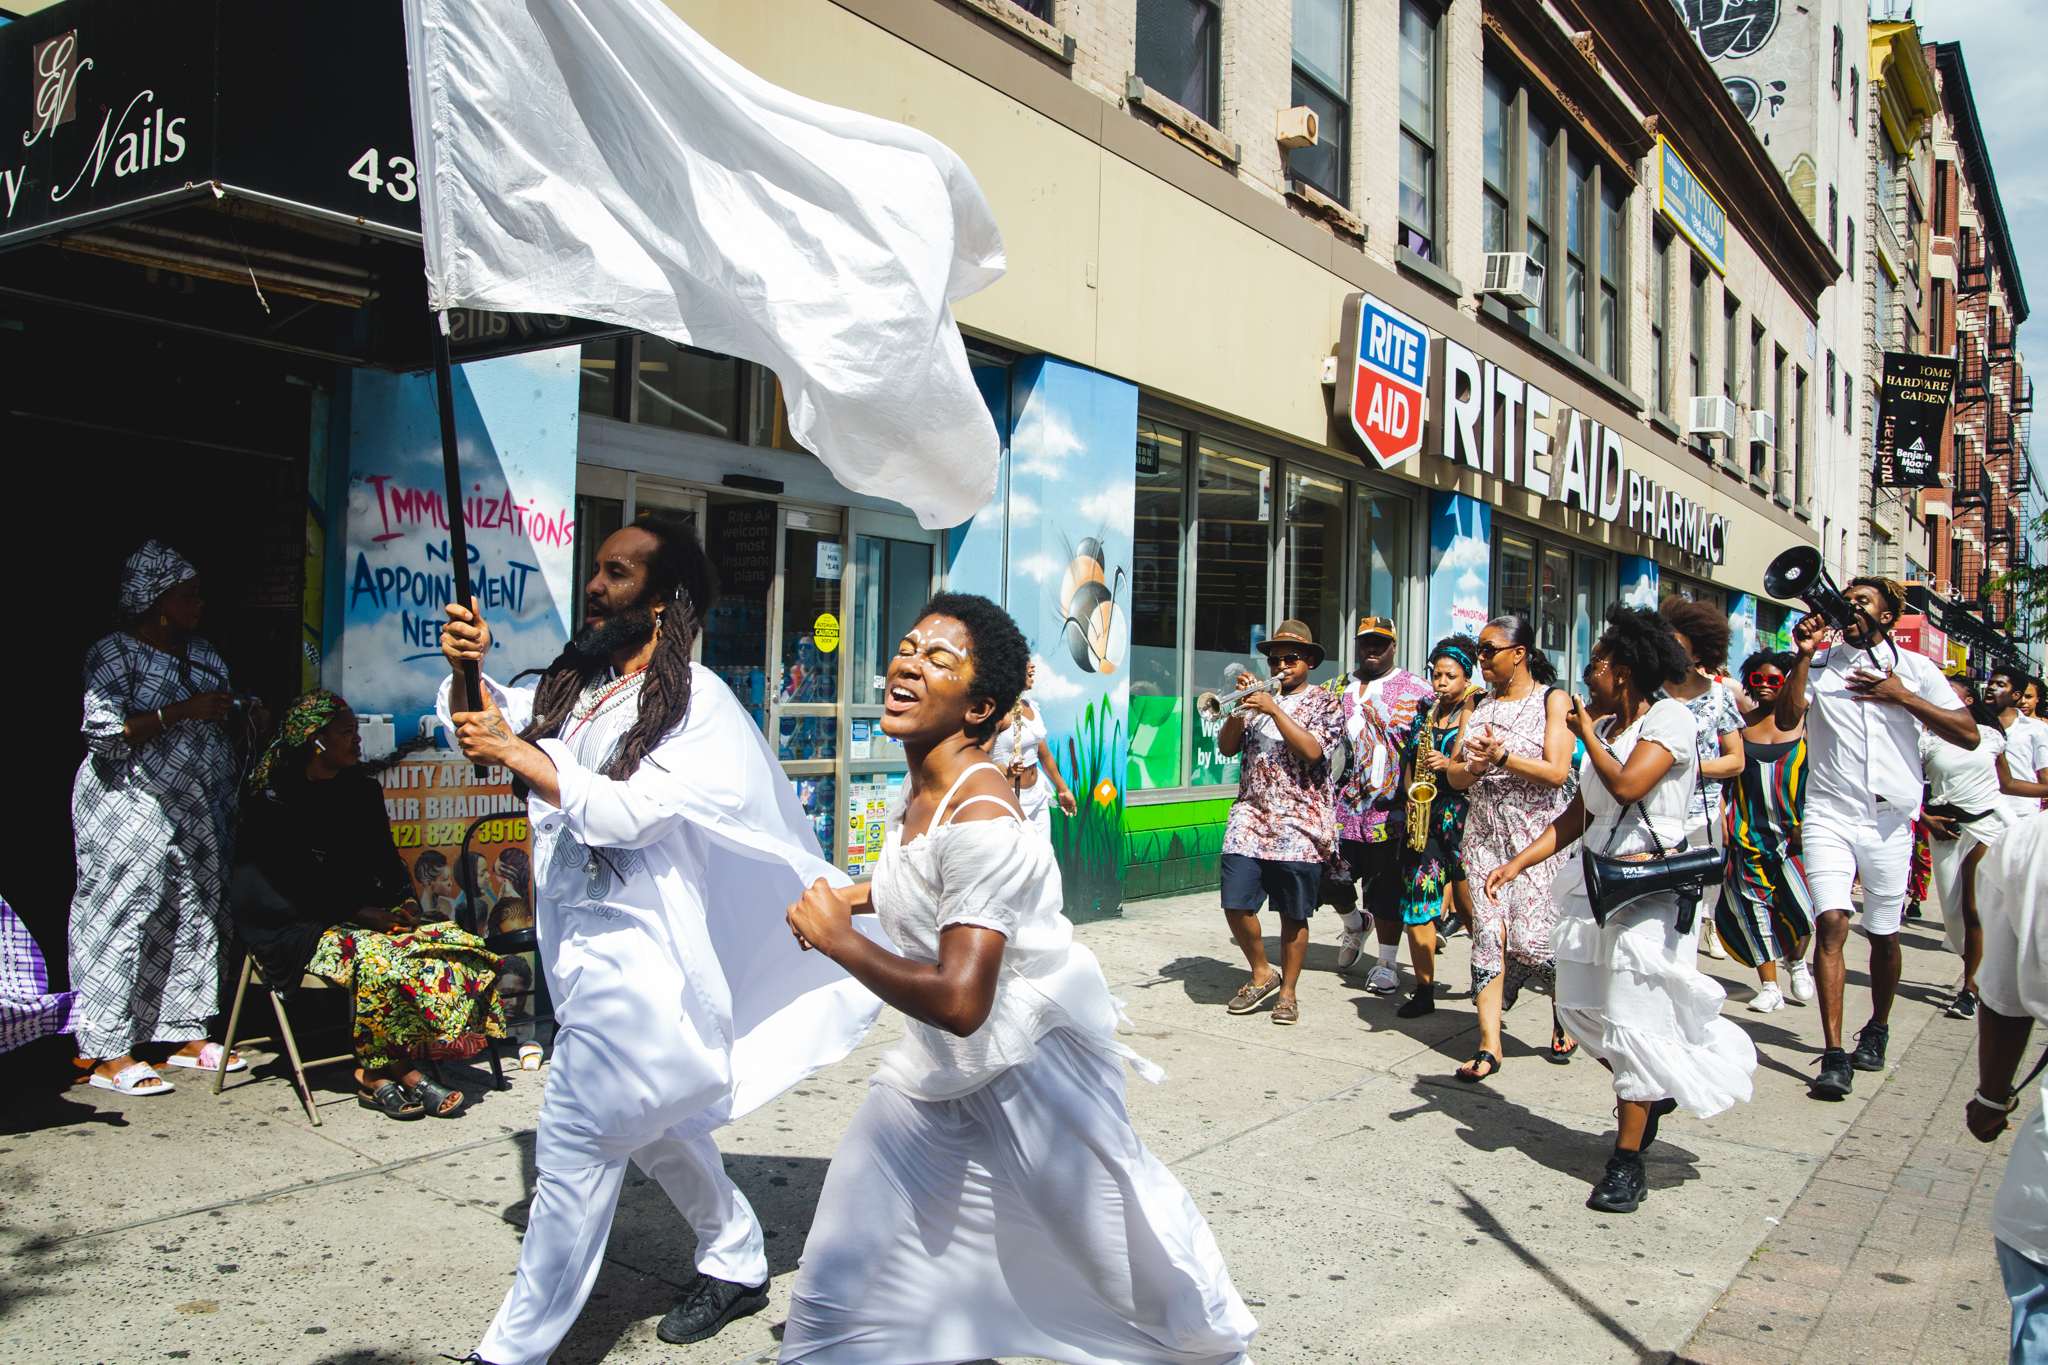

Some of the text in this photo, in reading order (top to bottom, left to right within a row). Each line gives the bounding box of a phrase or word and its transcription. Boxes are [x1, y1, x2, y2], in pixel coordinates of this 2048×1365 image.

[51, 89, 186, 202] Nails
[1666, 152, 1682, 178] STUDIO
[1683, 168, 1724, 240] TATTOO
[1369, 312, 1419, 378] RITE
[1366, 382, 1410, 439] AID
[1444, 338, 1732, 566] RITE AID PHARMACY
[728, 510, 751, 523] Rite
[736, 539, 765, 552] most
[351, 551, 539, 612] APPOINMENT
[735, 568, 765, 583] plans
[815, 629, 839, 637] CAUTION
[1197, 747, 1212, 769] by
[478, 819, 527, 844] 3916
[1621, 866, 1645, 875] PYLE
